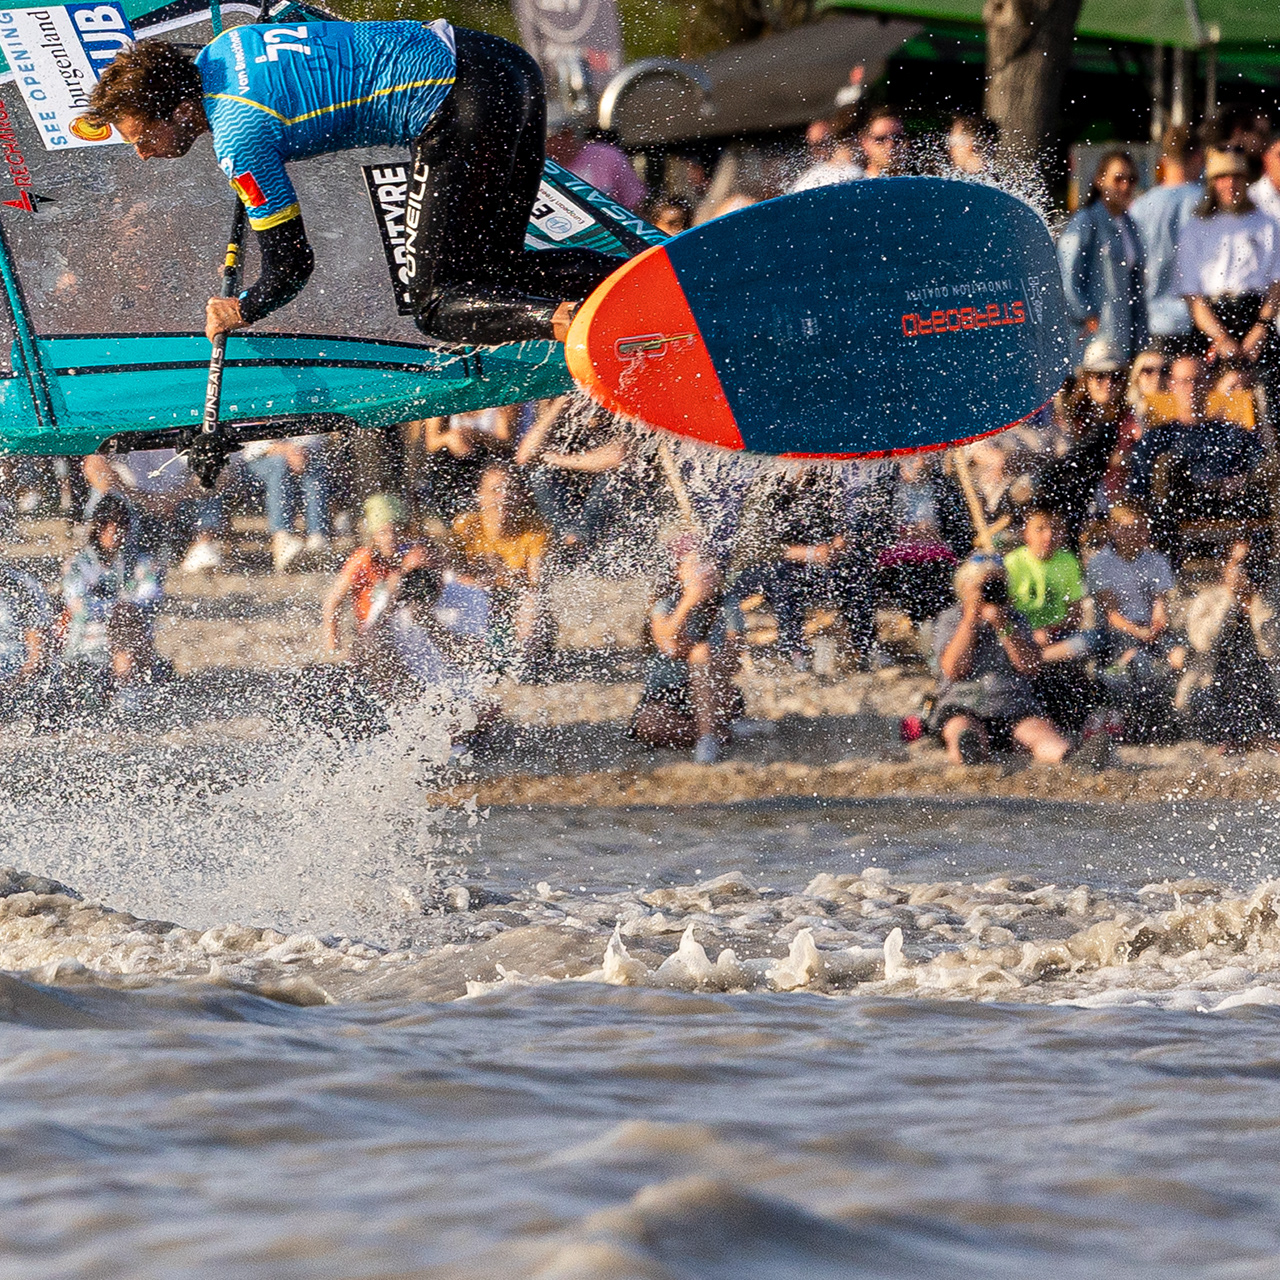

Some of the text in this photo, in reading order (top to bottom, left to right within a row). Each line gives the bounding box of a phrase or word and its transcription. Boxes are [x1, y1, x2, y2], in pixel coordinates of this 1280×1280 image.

[27, 10, 90, 109] burgenland
[73, 5, 136, 75] UB
[262, 25, 311, 62] 72
[237, 70, 251, 96] Van
[40, 111, 69, 146] SEE
[202, 346, 224, 434] GUNSAILS
